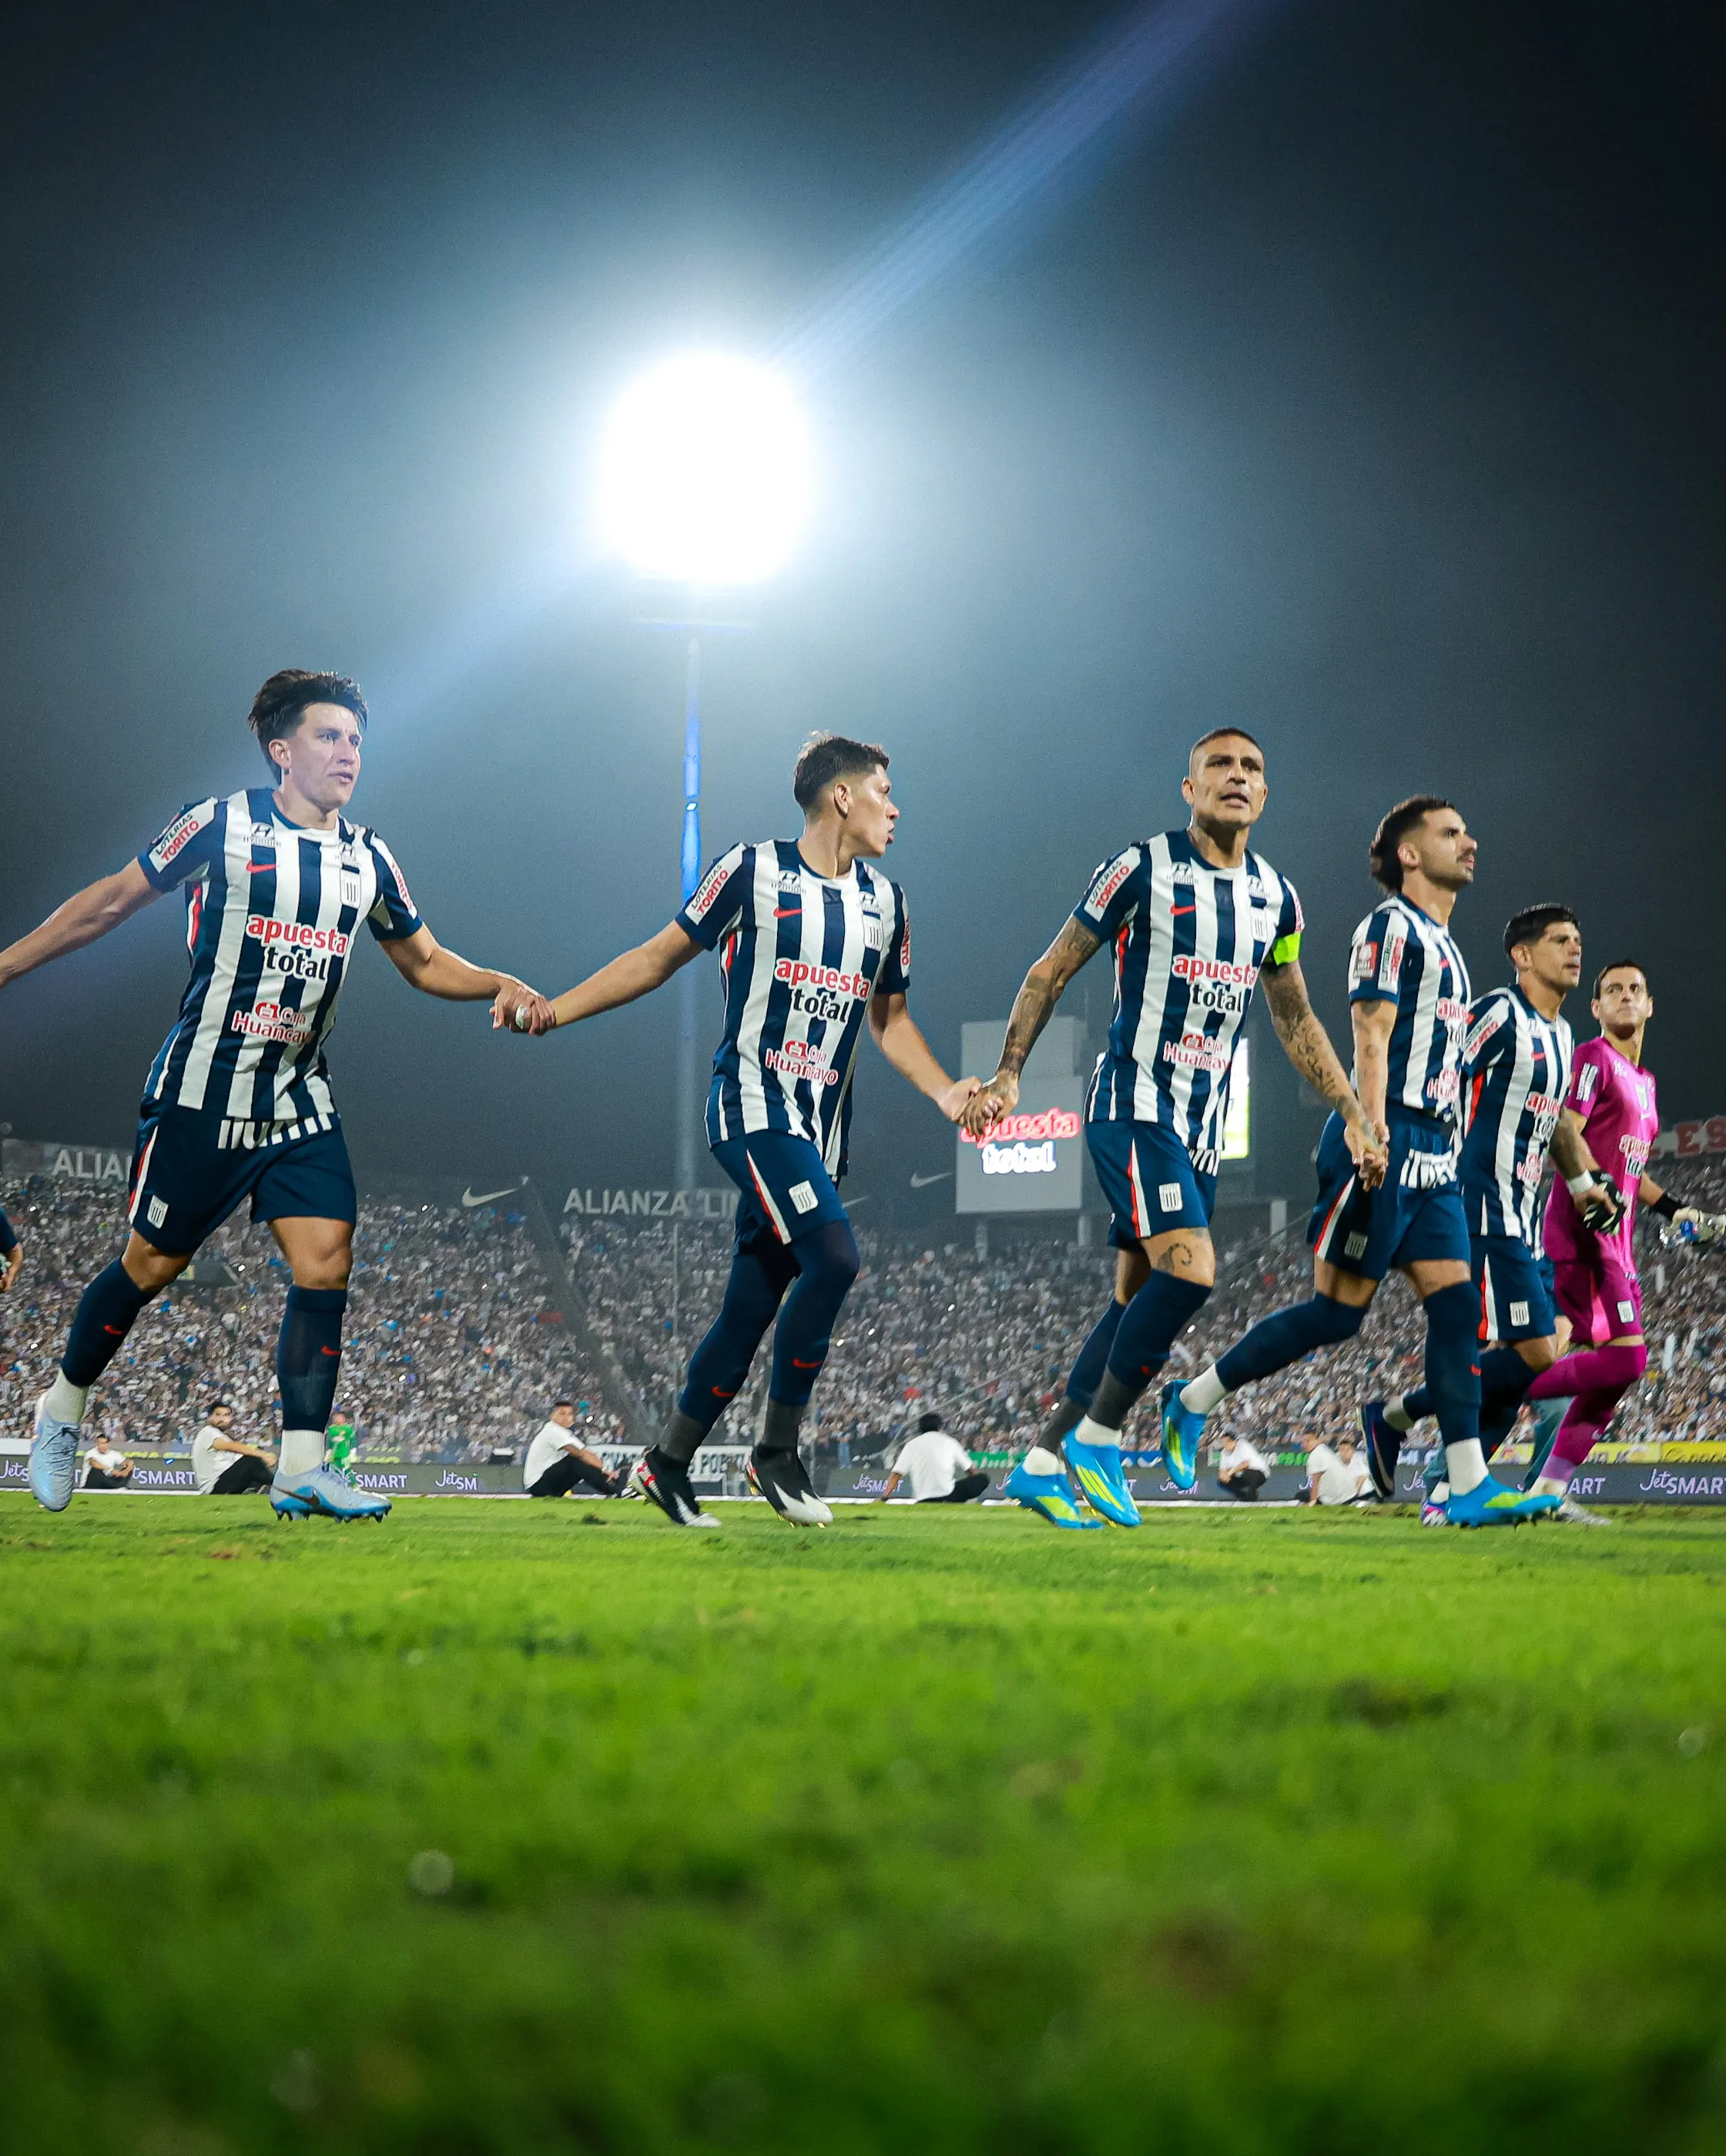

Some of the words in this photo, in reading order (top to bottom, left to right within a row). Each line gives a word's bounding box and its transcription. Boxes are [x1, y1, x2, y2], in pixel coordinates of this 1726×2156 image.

[155, 813, 193, 855] LOTERIAS
[161, 820, 199, 861] TORITO
[692, 865, 722, 909] LOTERIAS
[697, 870, 728, 914] TORITO
[1096, 865, 1129, 909] TORITO
[247, 916, 347, 955] apuesta
[266, 946, 327, 980] total
[776, 960, 870, 999] apuesta
[1174, 957, 1257, 986] apuesta
[793, 989, 850, 1023] total
[1192, 984, 1242, 1012] total
[282, 1008, 307, 1026] Caja
[766, 1050, 838, 1085] Huanayo
[1163, 1042, 1229, 1073] Huancay
[981, 1140, 1058, 1174] total
[563, 1188, 691, 1217] ALIANZA
[132, 1466, 195, 1485] tSMART
[354, 1473, 407, 1488] SMART
[853, 1473, 903, 1493] JetSMAT
